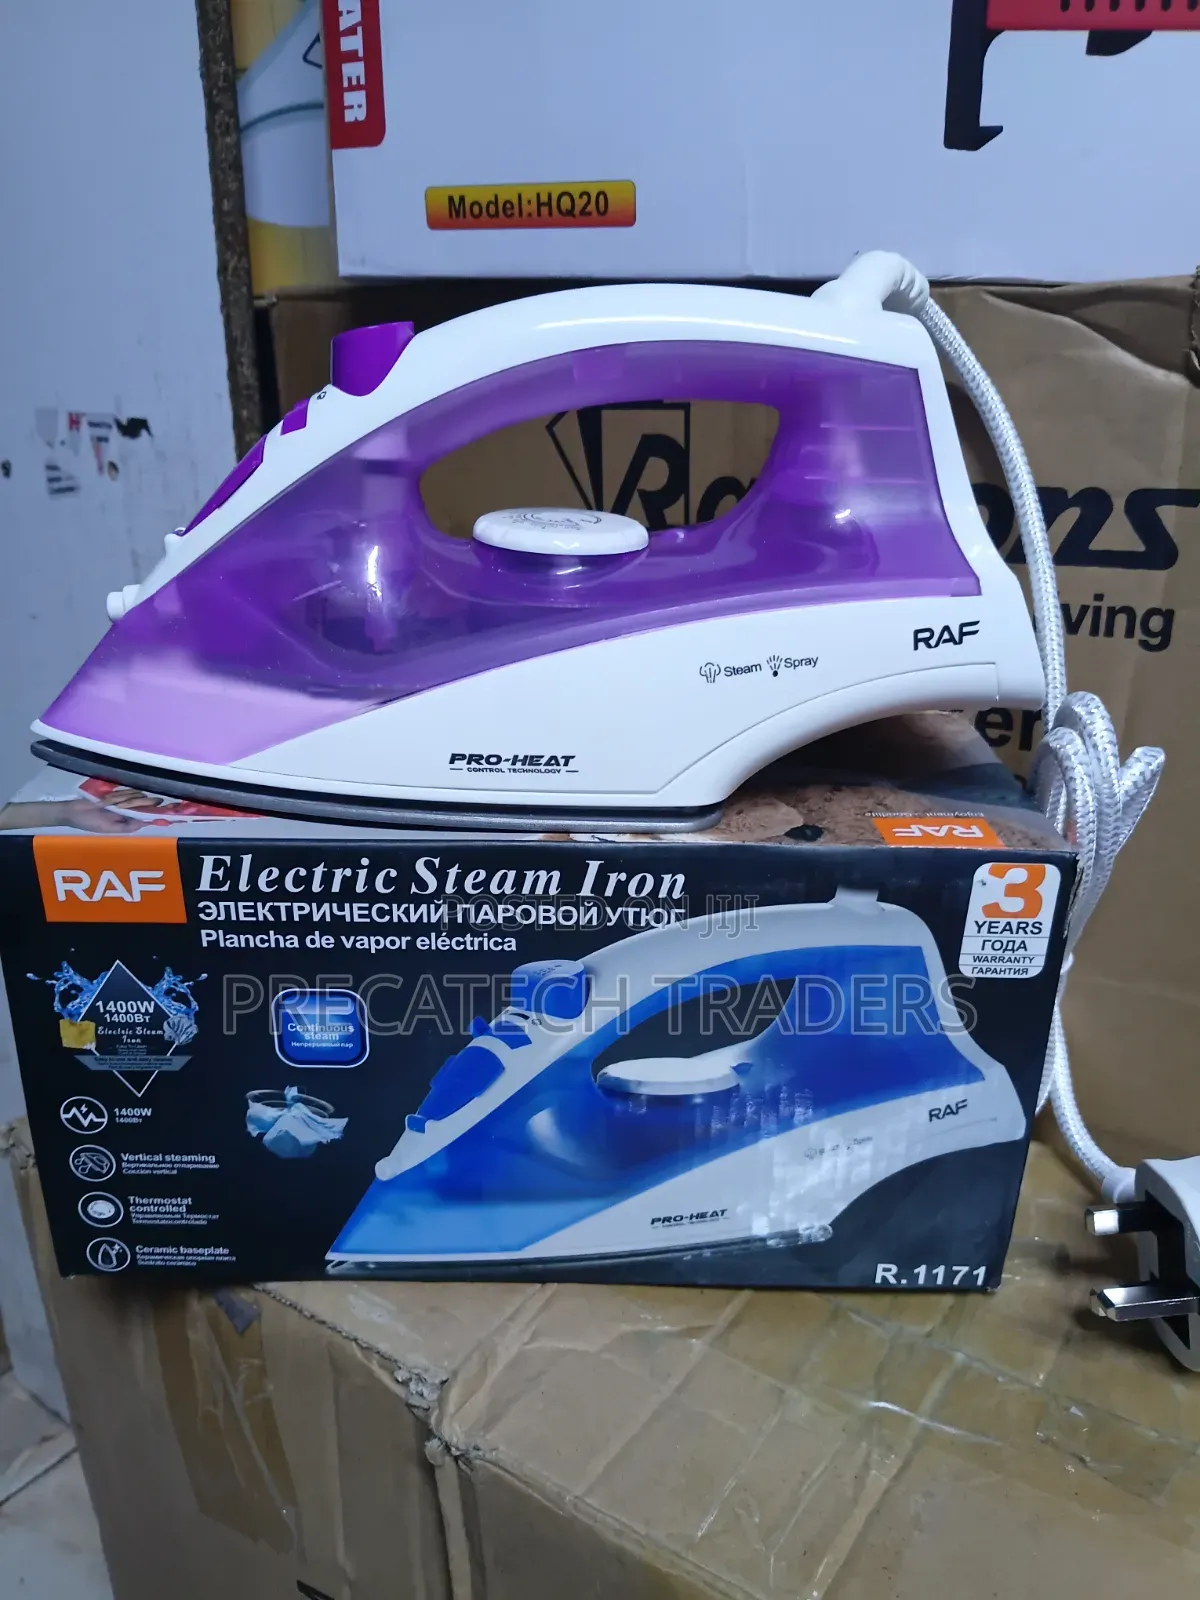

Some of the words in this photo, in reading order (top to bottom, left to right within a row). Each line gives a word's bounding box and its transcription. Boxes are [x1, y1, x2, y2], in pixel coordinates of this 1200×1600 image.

[447, 190, 609, 220] Model:HQ20
[913, 620, 980, 651] RAF
[723, 663, 762, 678] Steam
[784, 655, 819, 670] Spray
[449, 753, 576, 767] PRO-HEAT
[892, 824, 984, 838] RAF
[195, 854, 398, 893] Electric
[411, 856, 561, 895] Steam
[575, 860, 686, 899] Iron
[53, 869, 166, 902] RAF
[981, 864, 1046, 919] 3
[197, 900, 448, 924] ЭЛЕКТРИЧЕСКИЙ
[456, 902, 599, 926] ПАРОВОЙ
[974, 920, 1043, 935] YEARS
[201, 929, 299, 949] Plancha
[305, 931, 335, 949] de
[341, 934, 411, 954] vapor
[416, 932, 517, 951] eléctrica
[981, 939, 1028, 954] ГОДА
[972, 955, 1035, 964] WARRANTY
[971, 966, 1028, 976] ГАРАНТИЯ
[95, 1000, 155, 1013] 1400W
[287, 1023, 355, 1033] Continuous
[304, 1032, 340, 1041] steam
[114, 1107, 152, 1117] 1400W
[928, 1099, 968, 1122] RAF
[120, 1152, 163, 1162] Vertical
[164, 1153, 216, 1163] steaming
[128, 1195, 192, 1205] Thermostat
[129, 1204, 187, 1213] controlled
[650, 1208, 728, 1225] PRO-HEAT
[135, 1244, 179, 1254] Ceramic
[180, 1245, 230, 1255] baseplate
[874, 1263, 987, 1286] R.1171
